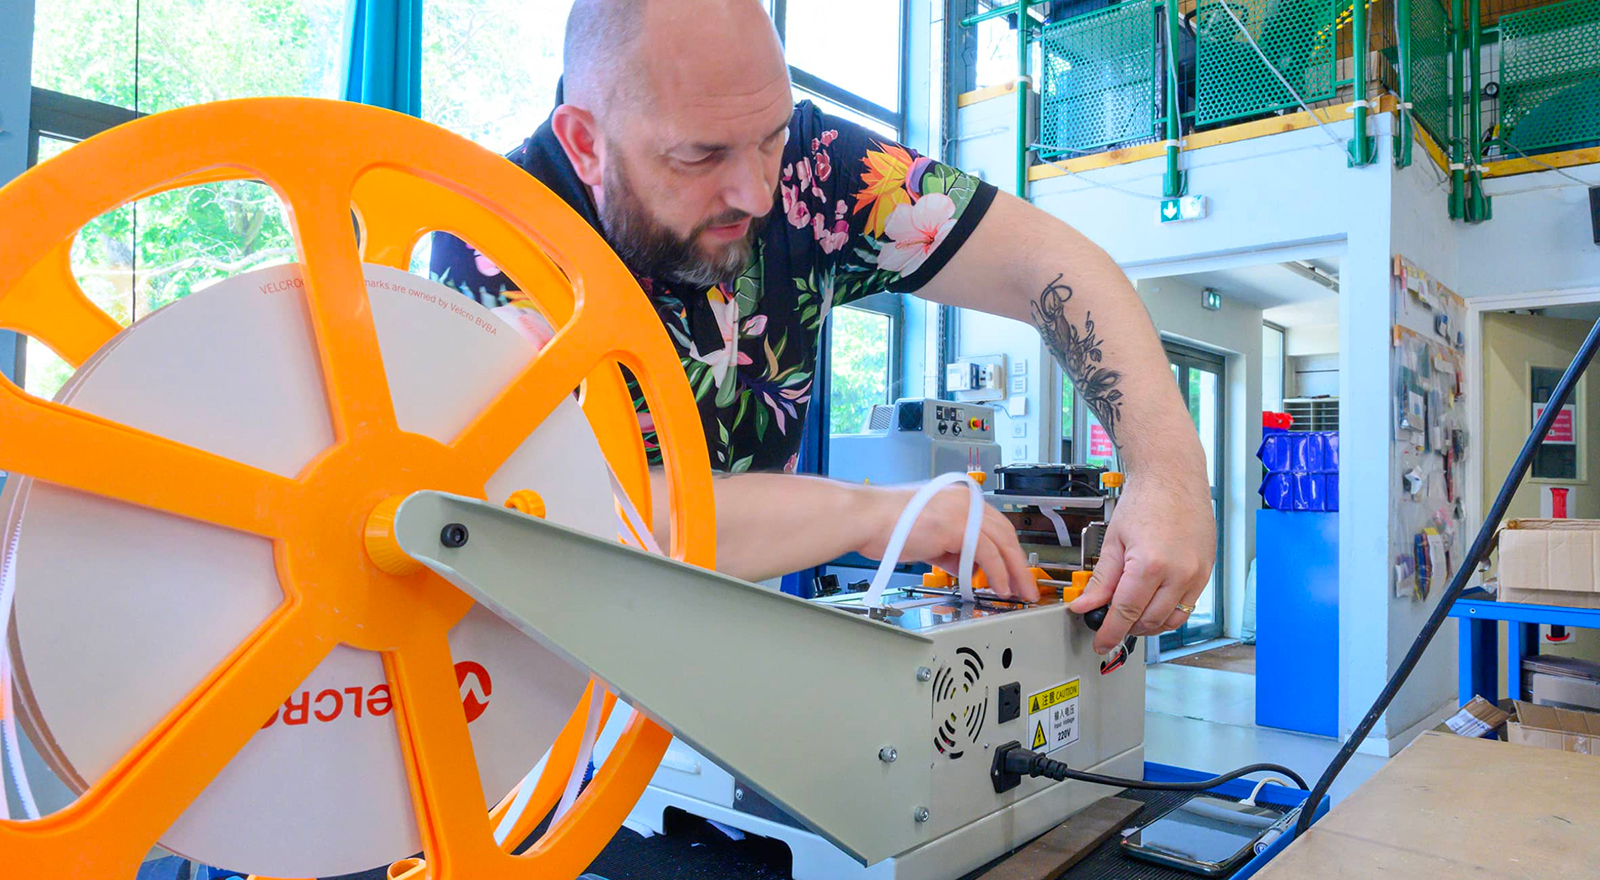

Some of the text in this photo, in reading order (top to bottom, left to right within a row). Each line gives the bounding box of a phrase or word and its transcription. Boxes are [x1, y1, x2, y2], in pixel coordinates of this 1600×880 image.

[391, 284, 406, 294] are
[408, 288, 436, 303] owned
[438, 298, 448, 309] by
[450, 302, 475, 321] Velcro
[475, 316, 497, 335] BVBA
[1042, 685, 1077, 706] 注意 CAUTION
[1058, 728, 1071, 741] 220V
